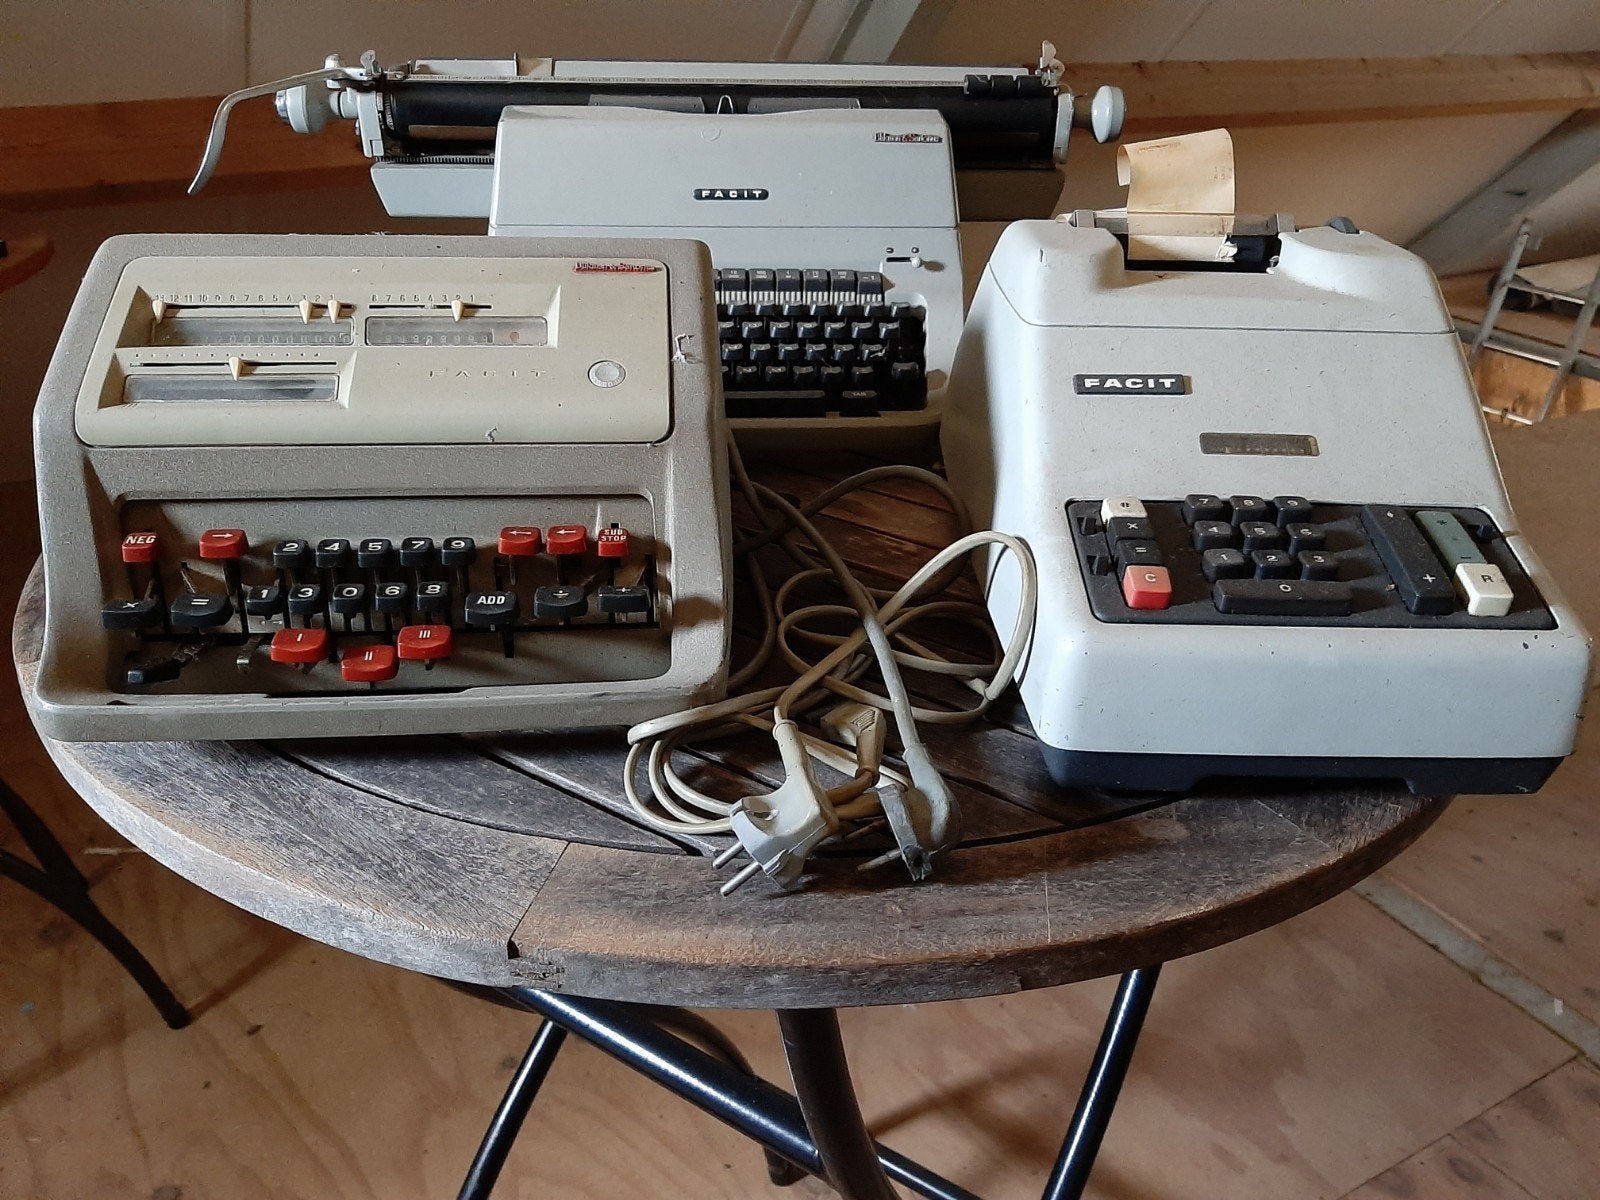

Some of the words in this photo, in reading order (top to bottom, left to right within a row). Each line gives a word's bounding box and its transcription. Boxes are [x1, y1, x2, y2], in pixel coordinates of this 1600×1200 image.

[702, 190, 762, 199] FACIT
[170, 294, 179, 302] 12
[184, 294, 193, 302] 11
[199, 294, 208, 302] 10
[244, 294, 250, 302] 7
[272, 294, 278, 302] 5
[315, 294, 321, 302] 2
[1084, 377, 1176, 389] FACIT
[125, 535, 156, 544] NEG
[282, 542, 299, 552] 2
[324, 542, 340, 551] 4
[368, 542, 383, 551] 5
[411, 541, 426, 549] 7
[451, 540, 466, 549] 9
[1221, 553, 1228, 561] 1
[1313, 555, 1325, 563] 3
[1145, 573, 1156, 582] C
[1481, 574, 1494, 582] R
[260, 589, 268, 598] 1
[298, 588, 313, 598] 3
[342, 587, 358, 597] 0
[385, 586, 400, 596] 6
[426, 585, 441, 594] 8
[1279, 584, 1292, 593] 0
[477, 595, 505, 605] ADD
